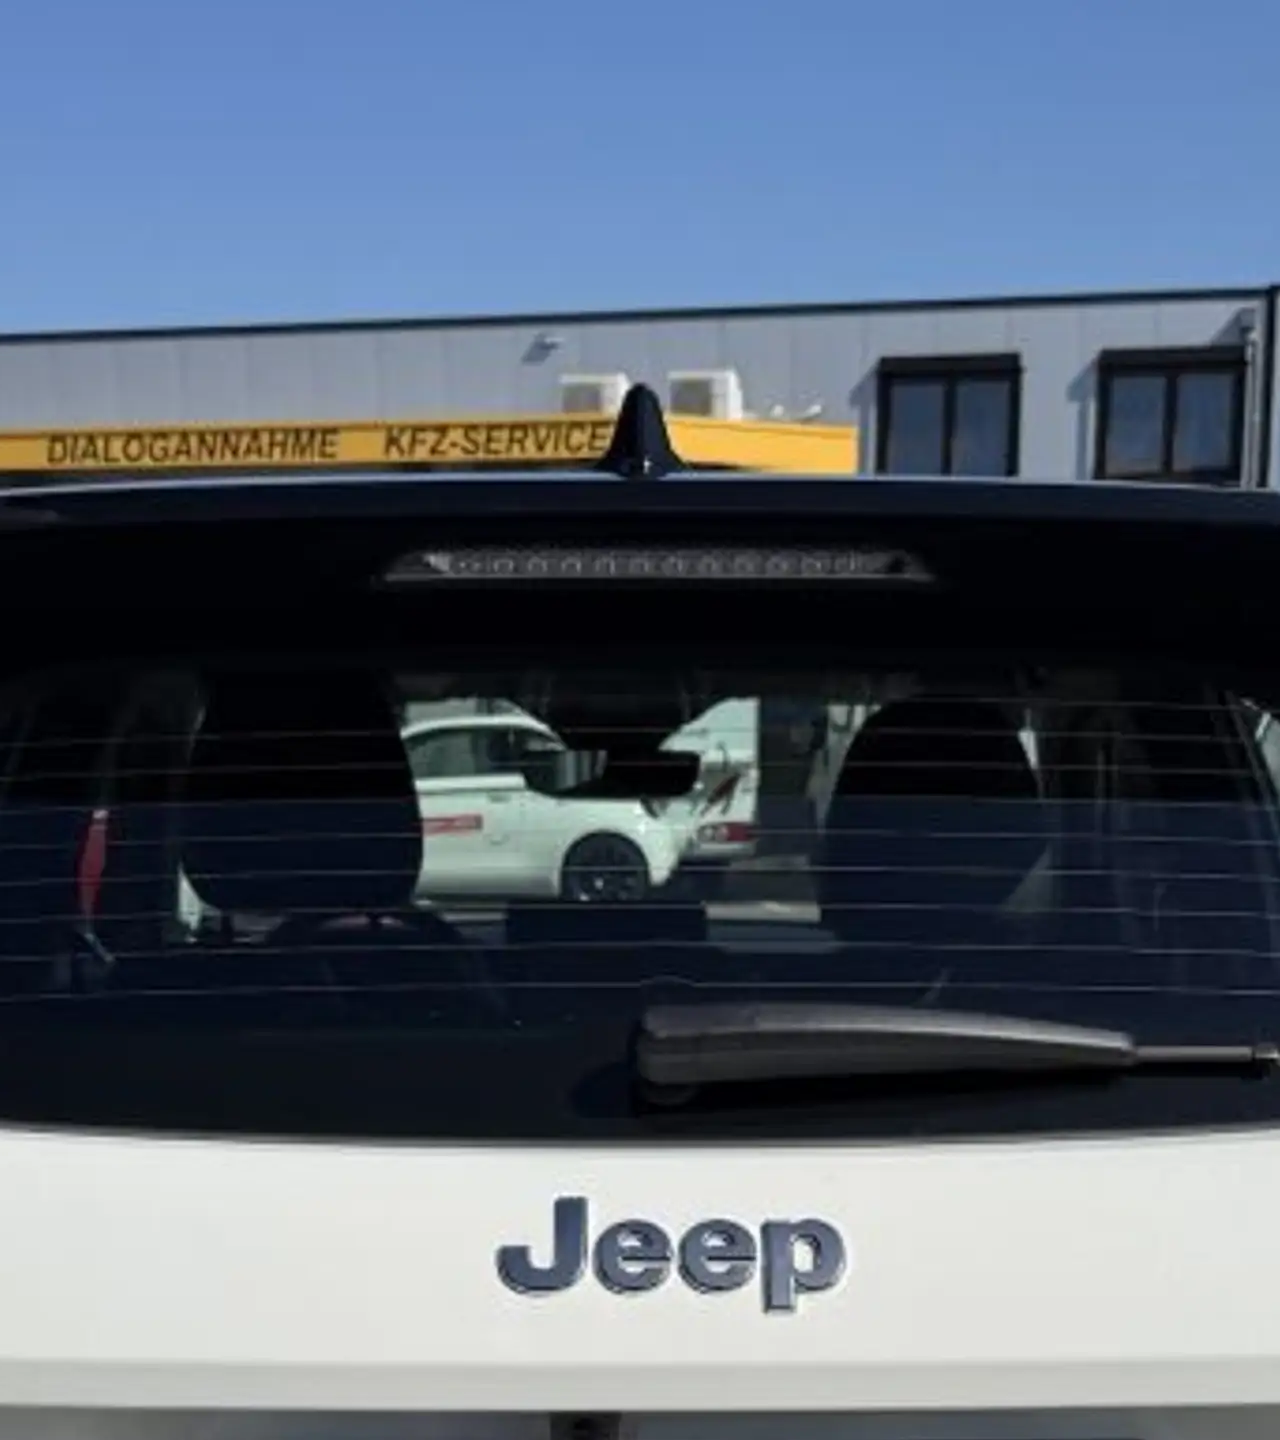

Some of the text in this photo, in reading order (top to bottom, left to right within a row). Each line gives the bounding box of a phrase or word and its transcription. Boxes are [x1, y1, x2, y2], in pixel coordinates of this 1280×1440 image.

[46, 421, 612, 465] DIALOGANNAHME KFZ-SERVICE
[495, 1196, 846, 1314] Jeep
